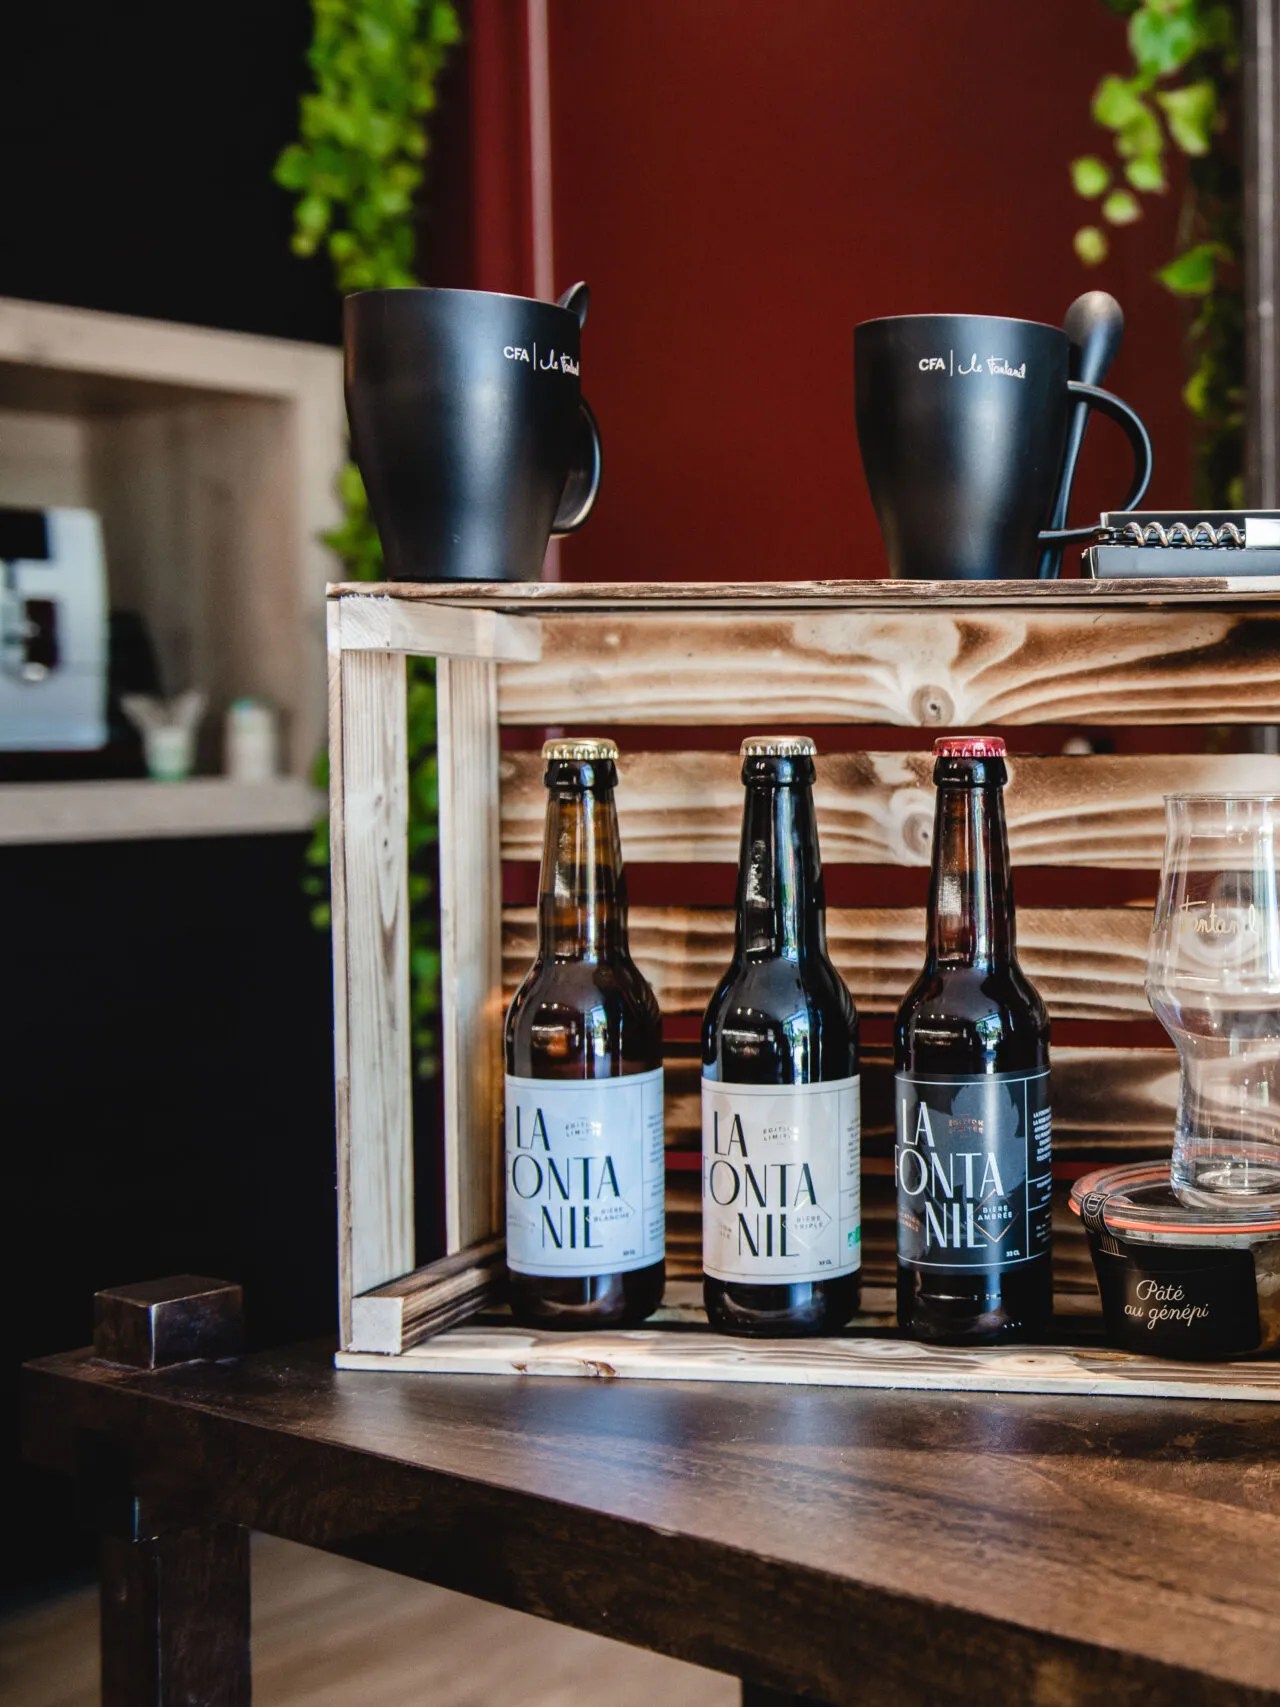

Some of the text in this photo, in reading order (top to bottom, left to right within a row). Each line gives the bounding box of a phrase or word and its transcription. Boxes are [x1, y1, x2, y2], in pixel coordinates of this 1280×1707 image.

[503, 345, 530, 363] CFA
[918, 357, 946, 371] CFA
[515, 1105, 551, 1152] LA
[713, 1110, 748, 1158] LA
[902, 1098, 936, 1148] LA
[541, 1204, 604, 1249] NIL
[737, 1211, 800, 1258] NIL
[925, 1201, 988, 1249] NIL
[977, 1211, 1013, 1221] AMBRÉE
[1136, 1279, 1185, 1301] Pâté
[1124, 1303, 1209, 1330] au génépi
